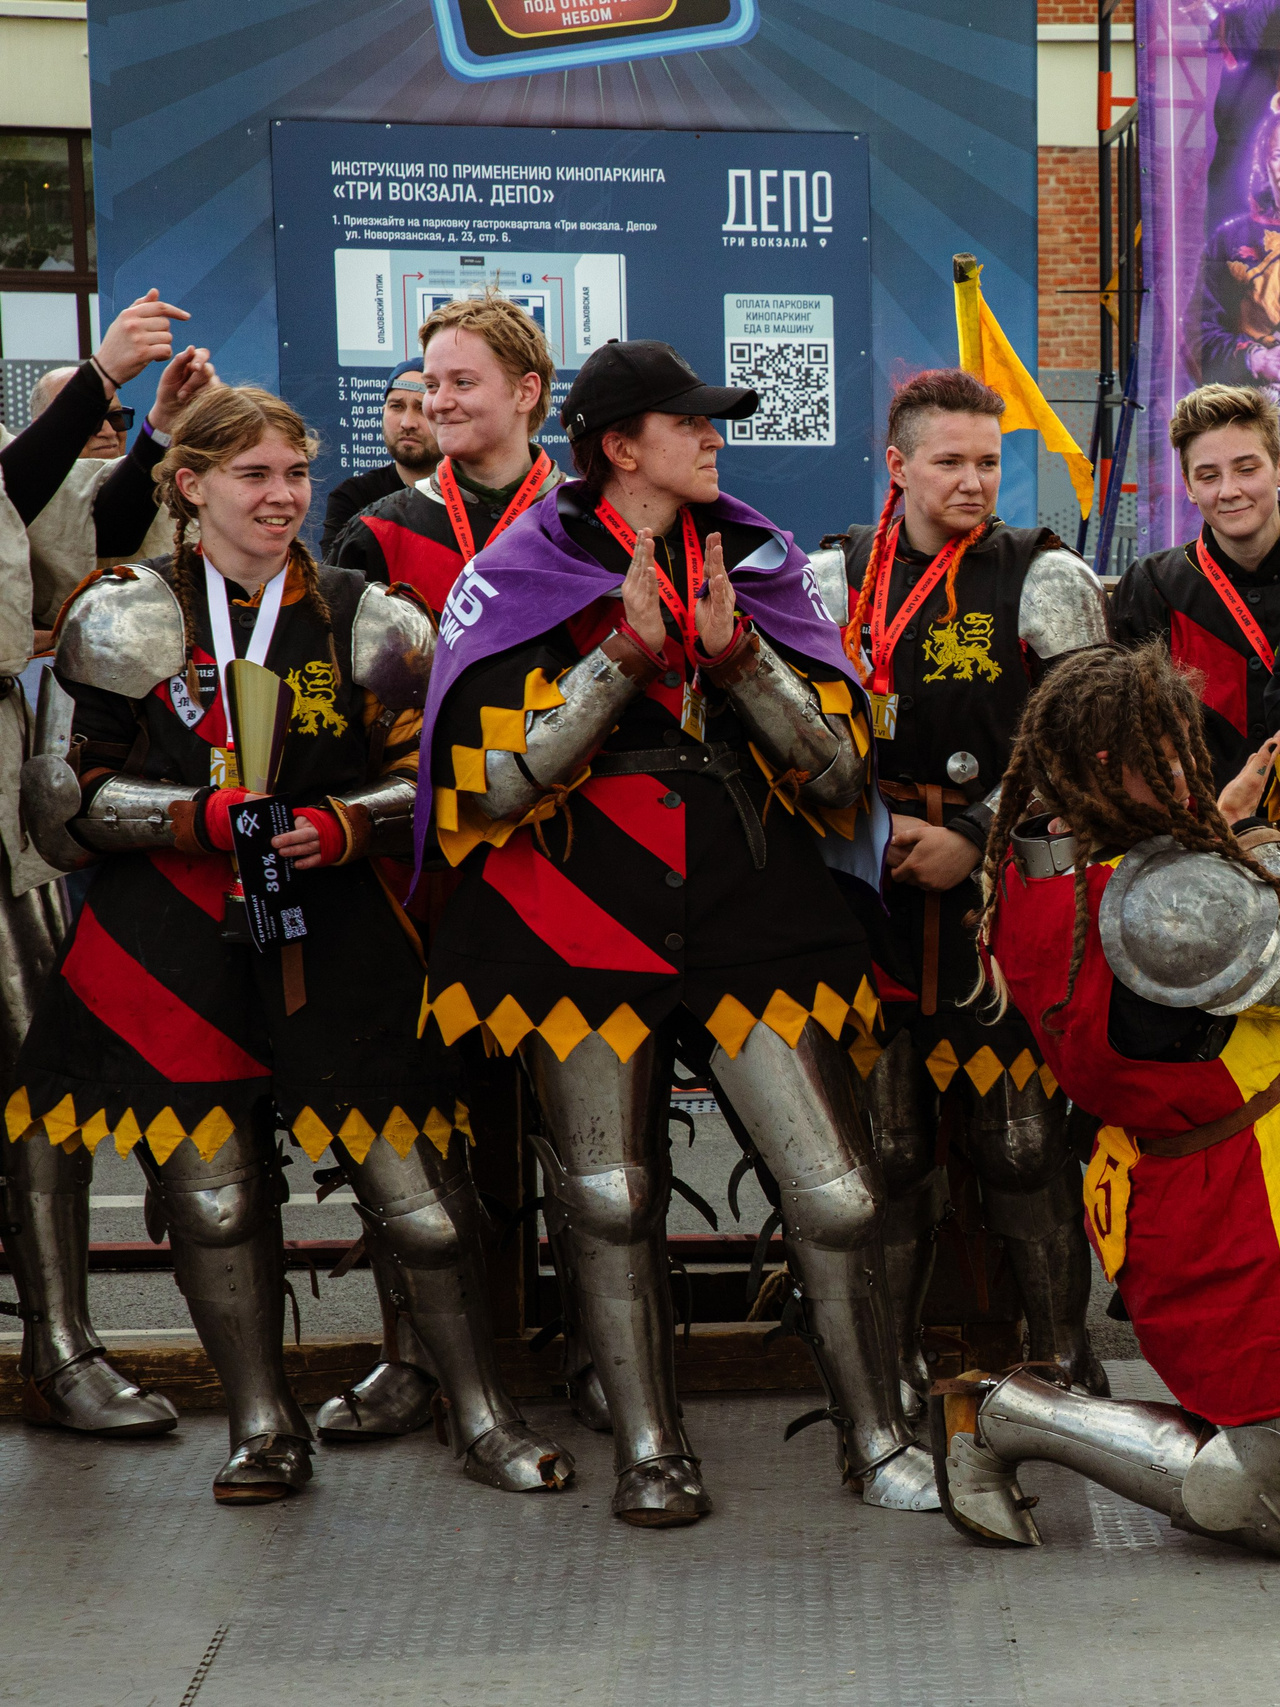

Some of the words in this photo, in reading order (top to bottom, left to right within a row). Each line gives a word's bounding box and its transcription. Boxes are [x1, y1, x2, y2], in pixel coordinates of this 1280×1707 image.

[524, 0, 555, 14] ПОД
[562, 7, 612, 26] НЕБОМ
[331, 161, 424, 179] ИНСТРУКЦИЯ
[429, 164, 448, 178] ПО
[452, 165, 552, 180] ПРИМЕНЕНИЮ
[556, 167, 666, 183] КИНОПАРКИНГА
[333, 181, 382, 201] «ТРИ
[389, 183, 484, 203] ВОКЗАЛА.
[490, 184, 555, 207] ДЕПО»
[722, 169, 833, 233] ДЕПО
[332, 215, 341, 226] 1.
[344, 215, 405, 227] Приезжайте
[408, 218, 420, 227] на
[422, 219, 470, 230] парковку
[472, 221, 552, 231] гастроквартала
[554, 220, 577, 232] «Три
[580, 222, 623, 232] вокзала.
[626, 221, 657, 233] Депо»
[345, 230, 362, 241] ул.
[364, 230, 445, 243] Новорязанская,
[448, 233, 459, 243] д.
[461, 232, 476, 243] 23,
[479, 233, 500, 244] стр.
[502, 232, 512, 243] 6.
[722, 237, 745, 247] ТРИ
[752, 237, 808, 248] ВОКЗАЛА
[376, 274, 384, 295] ТУПИК
[582, 287, 590, 332] ОЛЬХОВСКАЯ
[736, 299, 770, 309] ОПЛАТА
[773, 300, 821, 309] ПАРКОВКИ
[376, 297, 386, 344] ОЛЬХОВСКИЙ
[746, 311, 811, 321] КИНОПАРКИНГ
[744, 324, 761, 334] ЕДА
[764, 324, 770, 333] В
[773, 324, 814, 334] МАШИНУ
[338, 377, 347, 388] 2.
[339, 391, 348, 401] 3.
[351, 406, 364, 415] до
[367, 407, 383, 415] авт
[340, 417, 349, 427] 4.
[352, 417, 382, 429] Удобн
[352, 433, 358, 441] и
[361, 433, 373, 441] не
[341, 444, 350, 454] 5.
[353, 444, 388, 456] Настро
[341, 457, 350, 468] 6.
[353, 458, 394, 468] Наслаж
[262, 853, 279, 892] 30%
[251, 893, 265, 943] СЕРТИФИКАТ
